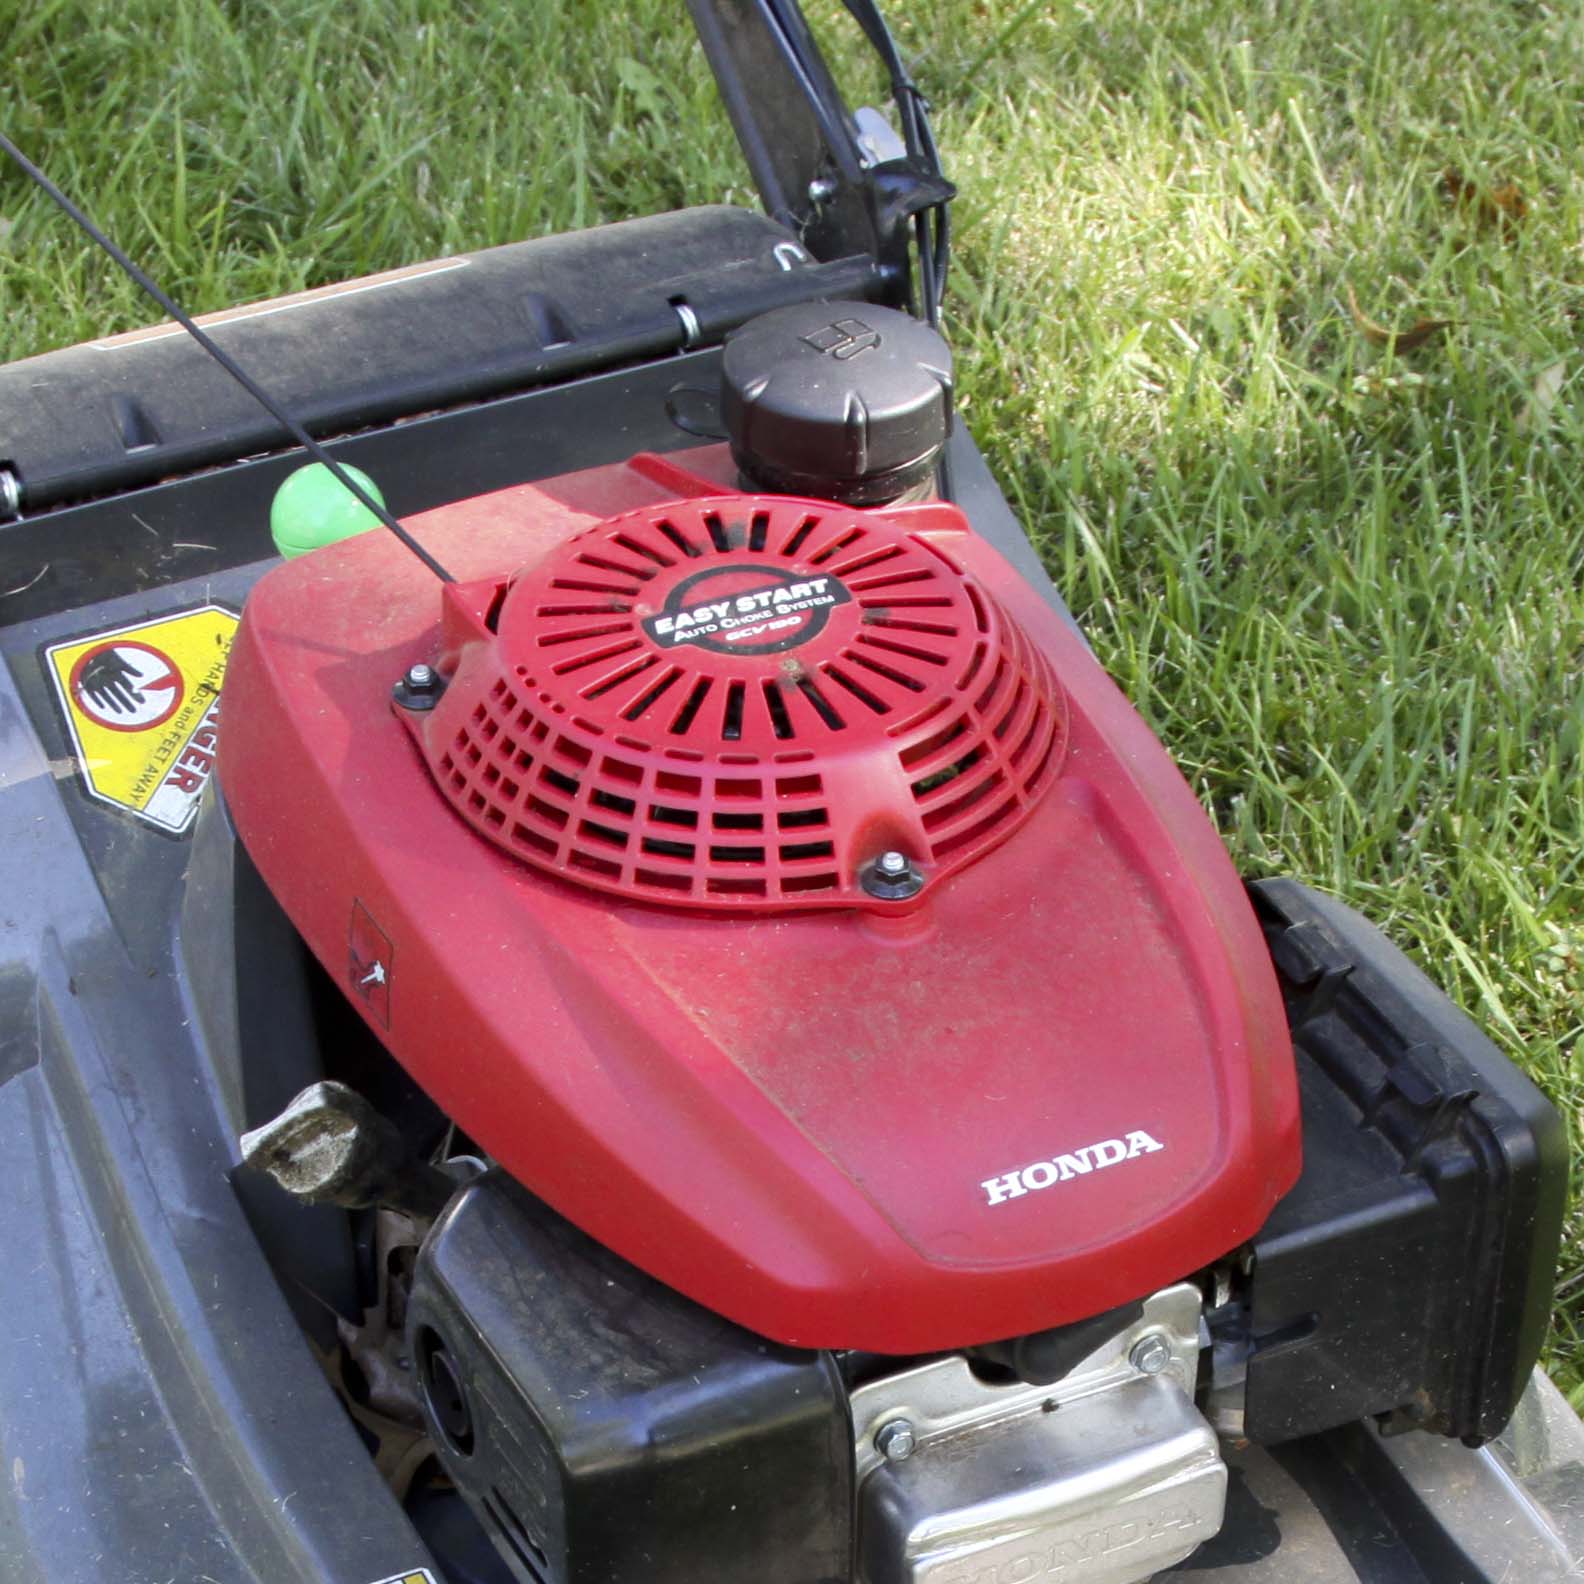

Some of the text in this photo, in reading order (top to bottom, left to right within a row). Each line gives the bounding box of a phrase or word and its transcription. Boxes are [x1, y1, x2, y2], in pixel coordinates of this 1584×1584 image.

[655, 578, 829, 635] EASY START
[673, 595, 835, 642] AUTO CHOKE SYSTEM
[174, 706, 195, 730] and
[153, 731, 182, 764] FEET
[129, 763, 159, 802] AWAY
[981, 1130, 1164, 1206] HONDA
